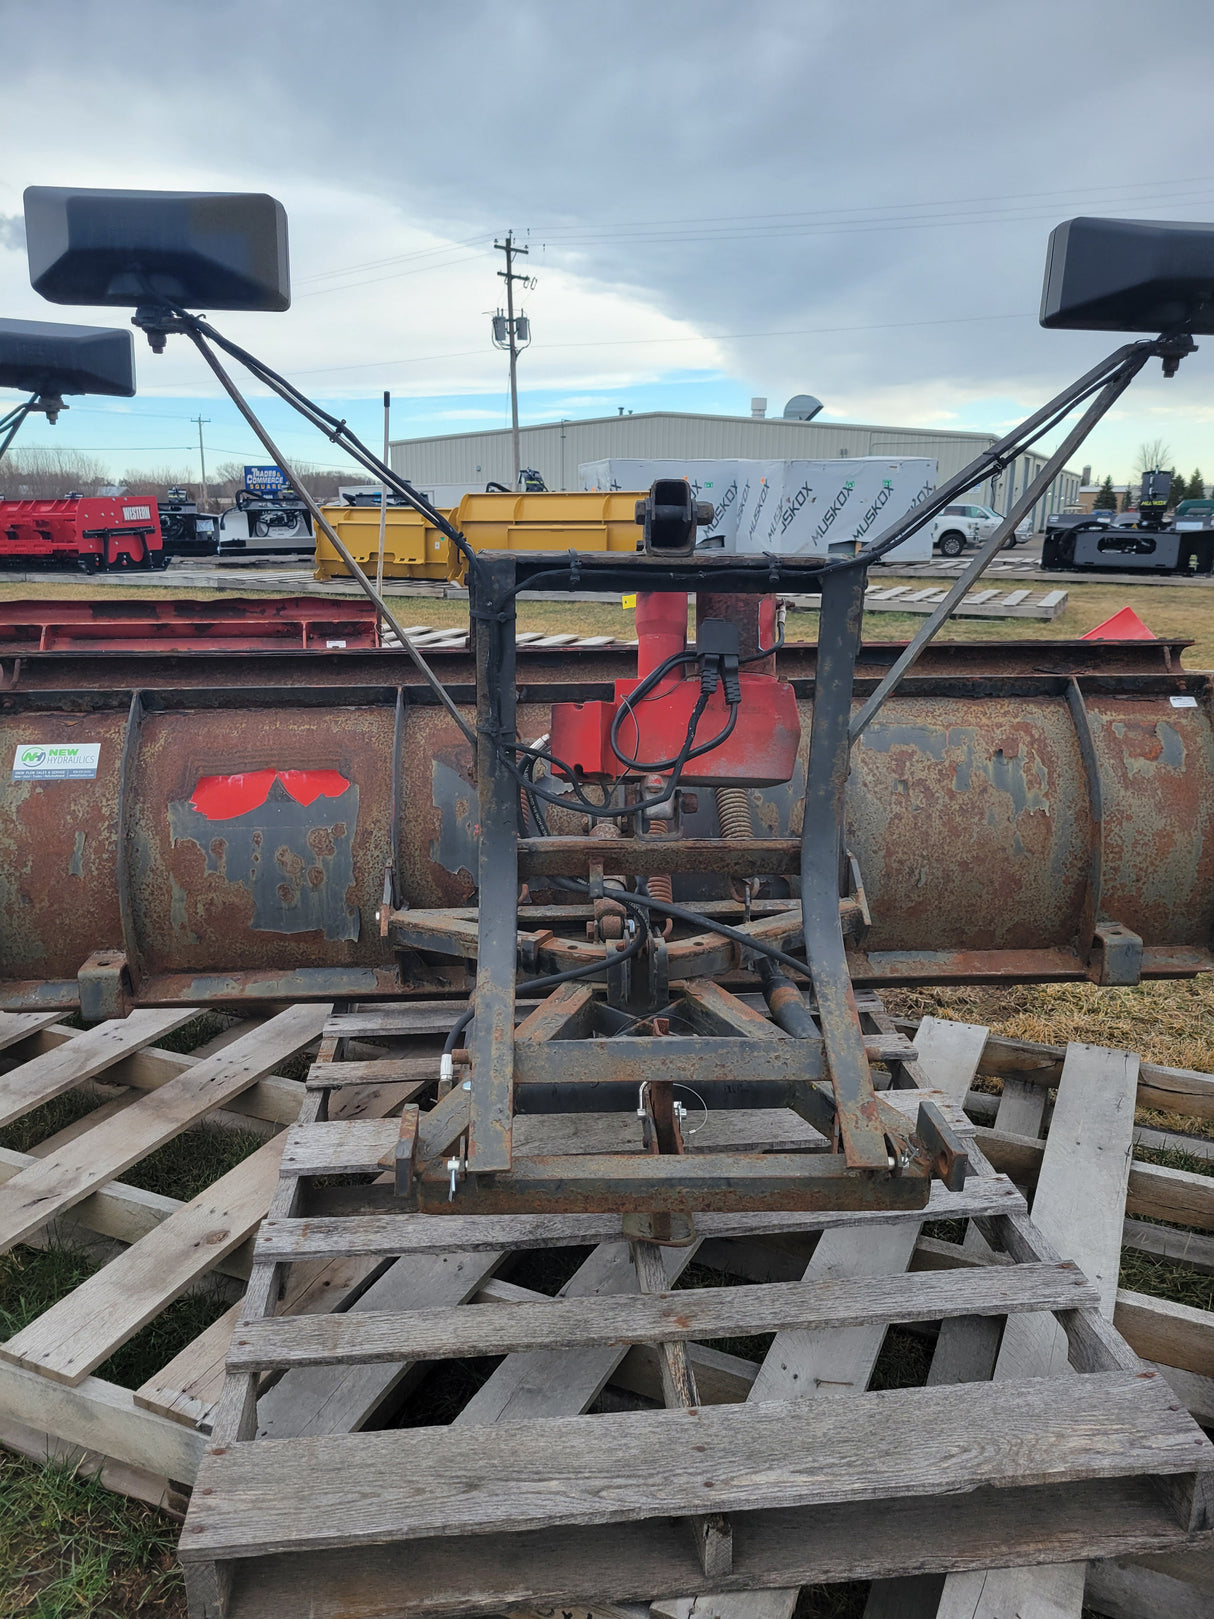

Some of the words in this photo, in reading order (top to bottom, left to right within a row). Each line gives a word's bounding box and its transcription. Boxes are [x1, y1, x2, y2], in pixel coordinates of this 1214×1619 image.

[251, 468, 276, 477] TRADES
[246, 475, 284, 484] COMMERCE
[122, 506, 151, 520] WESTERN
[811, 481, 854, 546] MUSKOX
[852, 481, 895, 542] MUSKOX
[47, 756, 95, 764] HYDRAULICS
